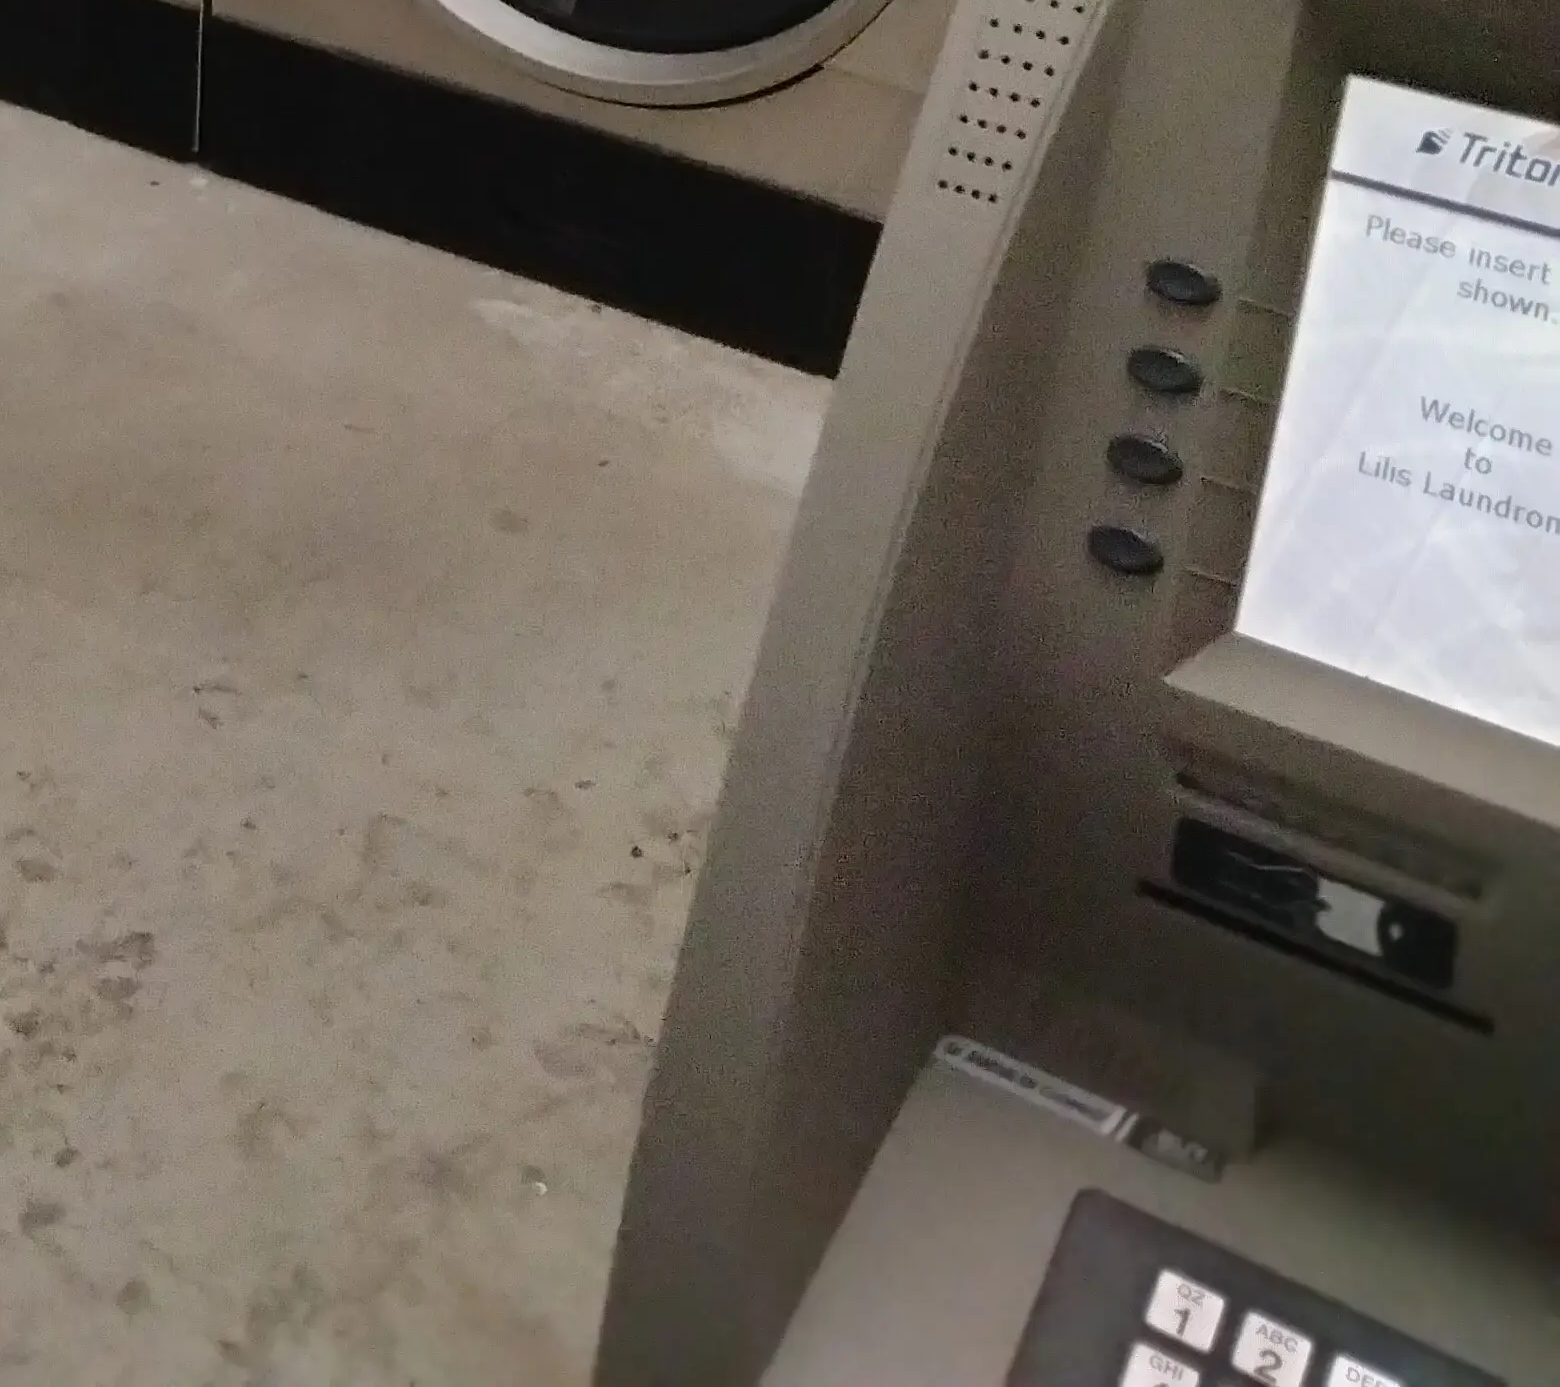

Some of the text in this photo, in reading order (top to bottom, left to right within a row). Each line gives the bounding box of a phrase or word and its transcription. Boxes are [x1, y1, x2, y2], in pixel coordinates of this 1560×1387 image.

[1366, 214, 1553, 285] Please insert
[1457, 278, 1559, 326] shown.
[1420, 396, 1553, 456] Welcome
[1358, 451, 1412, 487] Lilis
[1464, 447, 1493, 475] to
[1177, 1283, 1205, 1306] QZ
[1174, 1307, 1191, 1337] 1
[1256, 1324, 1299, 1353] ABC
[1149, 1354, 1185, 1381] GHI
[1254, 1349, 1283, 1384] 2
